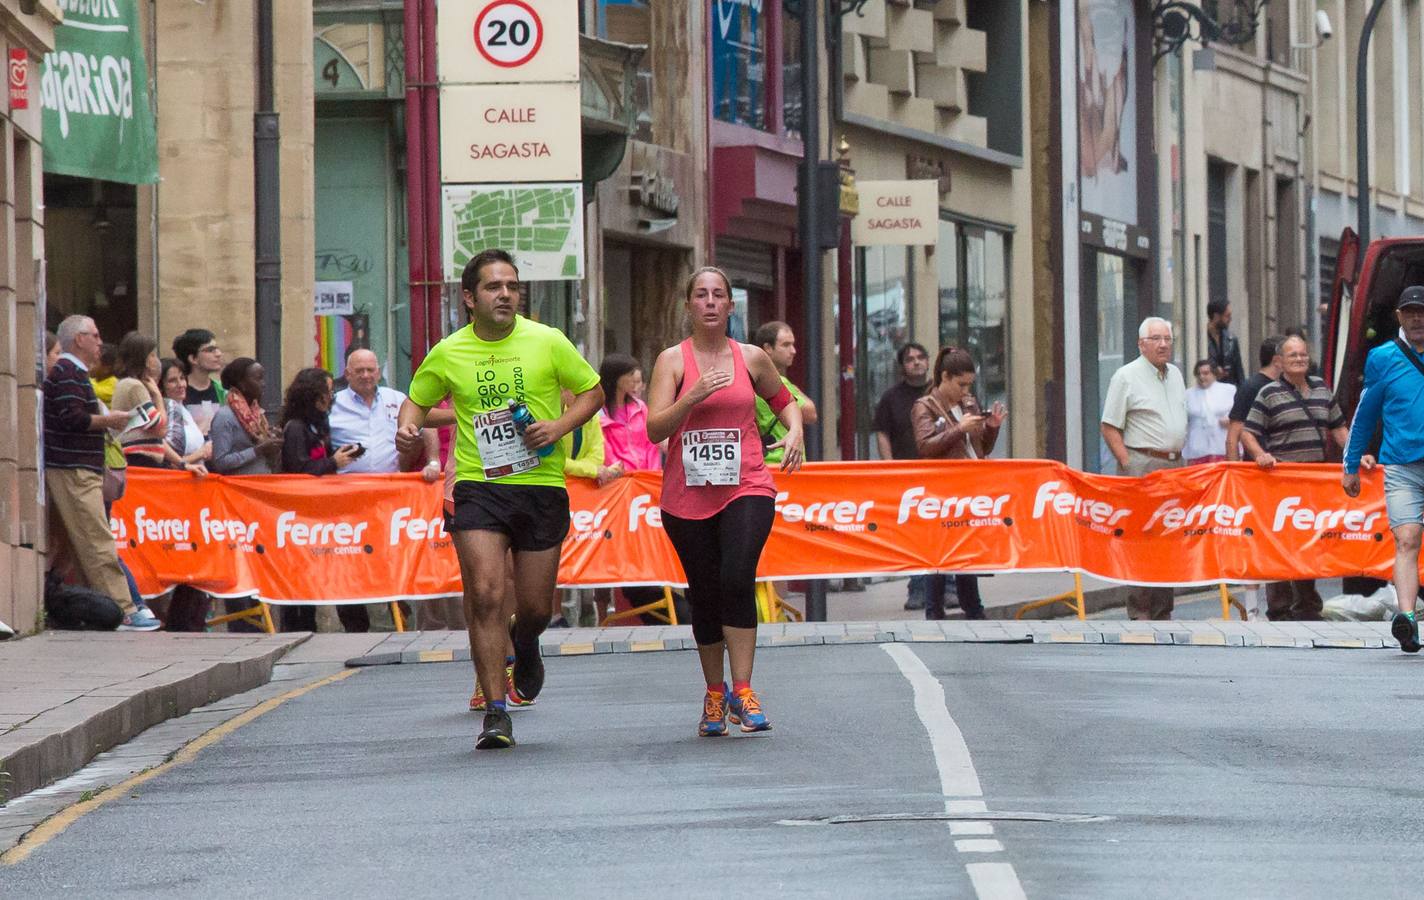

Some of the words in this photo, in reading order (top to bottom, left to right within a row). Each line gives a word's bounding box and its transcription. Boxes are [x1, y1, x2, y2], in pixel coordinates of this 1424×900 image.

[487, 20, 530, 46] 20
[484, 108, 536, 123] CALLE
[470, 142, 551, 159] SAGASTA
[876, 196, 912, 207] CALLE
[867, 218, 922, 230] SAGASTA
[476, 370, 495, 382] LO
[477, 383, 510, 396] GRO
[481, 422, 523, 445] 145
[689, 444, 735, 461] 1456
[1318, 530, 1372, 541] portcenter
